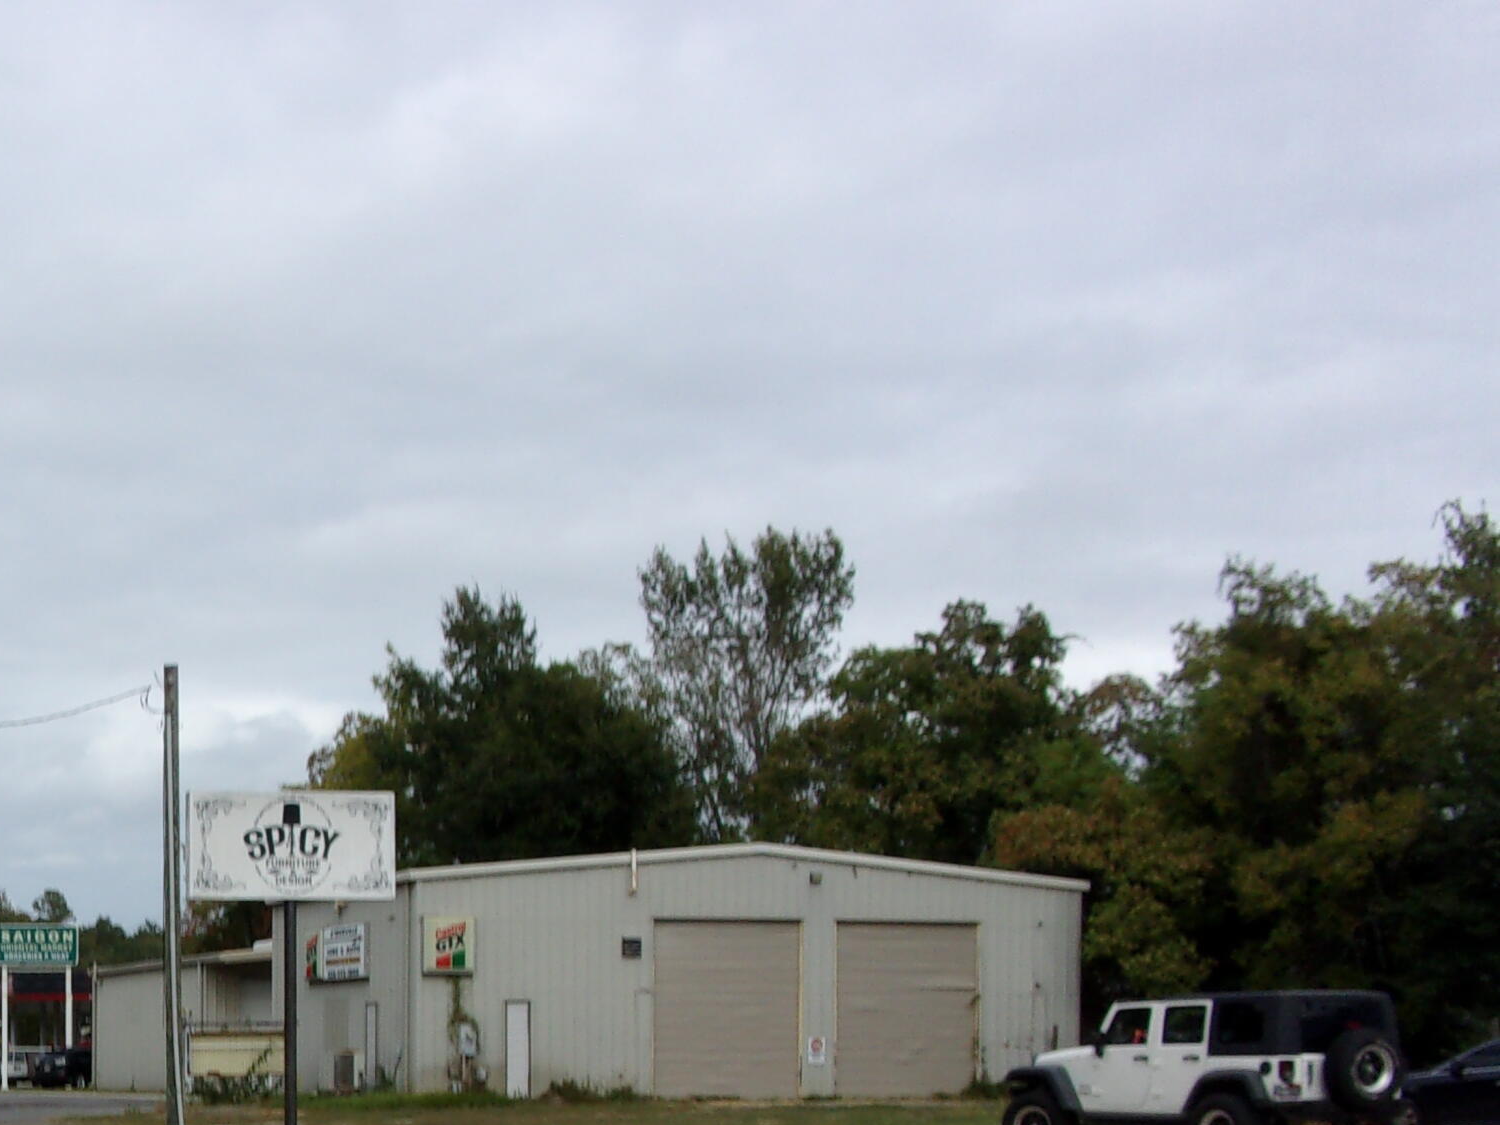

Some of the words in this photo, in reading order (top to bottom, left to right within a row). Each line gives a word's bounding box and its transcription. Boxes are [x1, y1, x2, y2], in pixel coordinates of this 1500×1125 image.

[243, 824, 340, 861] SPICY
[1, 930, 73, 944] SAIGON
[436, 935, 465, 952] GTX
